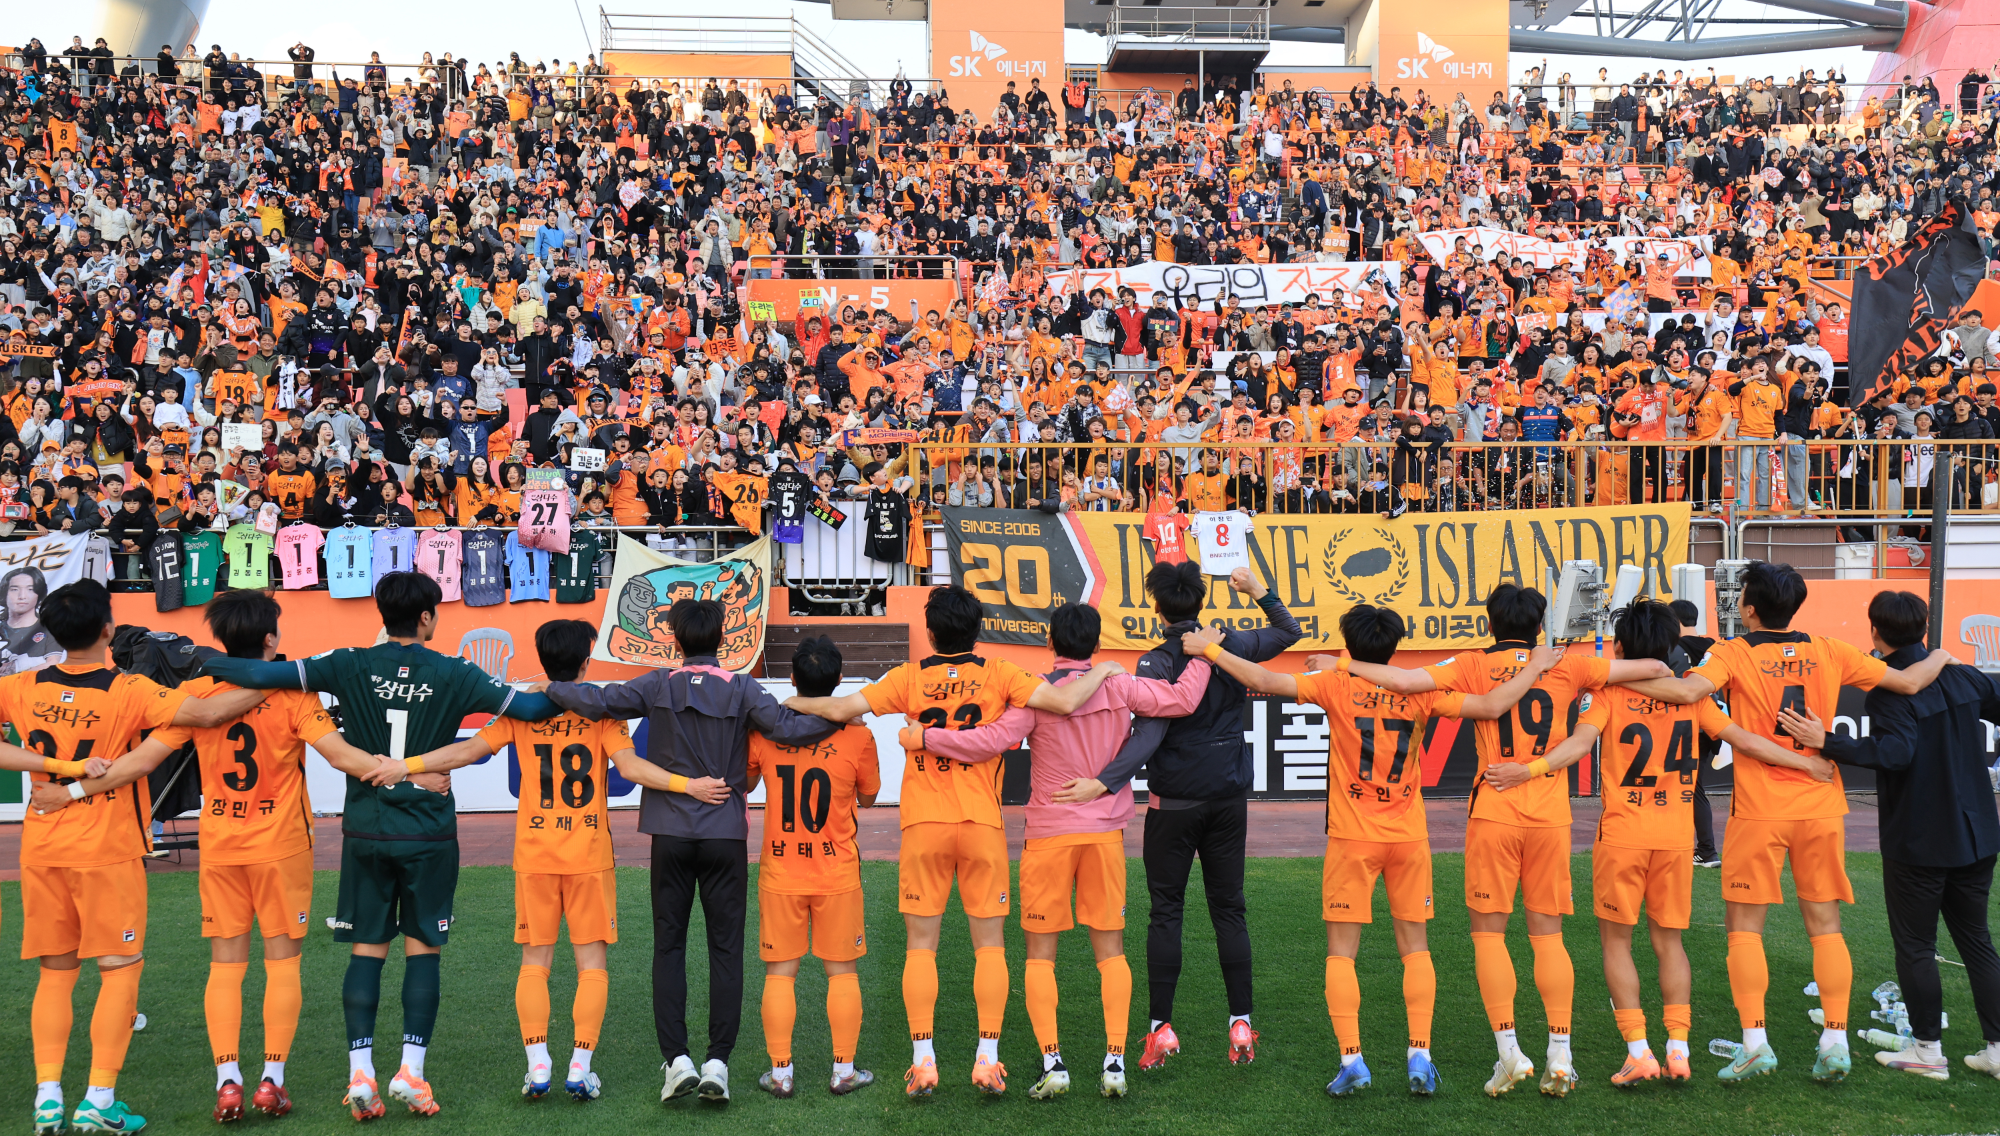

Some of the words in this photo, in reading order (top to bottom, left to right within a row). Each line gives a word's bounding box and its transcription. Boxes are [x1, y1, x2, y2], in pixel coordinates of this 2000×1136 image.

[949, 56, 981, 77] SK
[996, 60, 1046, 78] 에너지
[1396, 58, 1429, 79] SK
[1442, 61, 1492, 79] 에너지
[60, 129, 67, 140] 8
[1162, 266, 1268, 302] 우리의
[12, 345, 27, 353] SK
[30, 346, 44, 354] FC
[225, 386, 244, 405] 18
[467, 434, 476, 453] 1
[928, 427, 955, 443] 40
[1914, 444, 1934, 456] Lee
[285, 492, 299, 506] 4
[734, 482, 759, 504] 26
[531, 503, 558, 526] 27
[781, 492, 795, 518] 5
[880, 511, 893, 532] 5
[961, 519, 1002, 535] SINCE
[1004, 522, 1041, 537] 2006
[1158, 523, 1177, 545] 14
[1216, 524, 1230, 546] 8
[0, 543, 72, 571] 나는
[156, 551, 180, 581] 12
[190, 552, 199, 578] 1
[245, 543, 253, 567] 1
[293, 543, 302, 567] 1
[345, 545, 354, 569] 1
[389, 546, 398, 569] 1
[437, 550, 445, 574] 1
[478, 550, 486, 575] 1
[526, 552, 534, 576] 1
[570, 552, 578, 577] 1
[1113, 523, 1316, 608] INNE
[1414, 514, 1673, 608] ISLANDER
[87, 557, 94, 579] 1
[233, 569, 263, 577] 김동준
[336, 571, 366, 579] 김동준
[960, 542, 1052, 609] 20
[1052, 592, 1066, 608] th
[470, 577, 496, 586] 김동준
[560, 579, 586, 587] 김동준
[977, 616, 1051, 638] nniversary
[1121, 615, 1166, 640] 인세
[1765, 659, 1819, 678] 삼다수
[375, 680, 433, 702] 삼다수
[931, 679, 982, 701] 삼다수
[42, 705, 101, 729] 삼다수
[1497, 689, 1554, 758] 19
[1774, 685, 1806, 750] 4
[386, 708, 409, 761] 1
[223, 721, 259, 792] 3
[1354, 716, 1415, 784] 17
[1619, 720, 1699, 788] 24
[533, 743, 595, 810] 18
[776, 764, 832, 835] 10
[1348, 783, 1412, 803] 유인수
[1626, 789, 1694, 807] 최병욱
[211, 799, 276, 818] 장민규
[529, 814, 598, 831] 오재혁
[771, 839, 837, 859] 남태희
[979, 1030, 999, 1039] JEJU
[1754, 1020, 1764, 1028] JE
[1826, 1020, 1847, 1030] JEJU
[352, 1036, 372, 1049] JEJU
[525, 1035, 546, 1046] JEJU
[573, 1040, 590, 1050] EJU
[912, 1031, 932, 1041] JEJU
[216, 1053, 237, 1064] JEJU
[264, 1053, 281, 1061] EJU
[777, 1060, 791, 1068] JEJ
